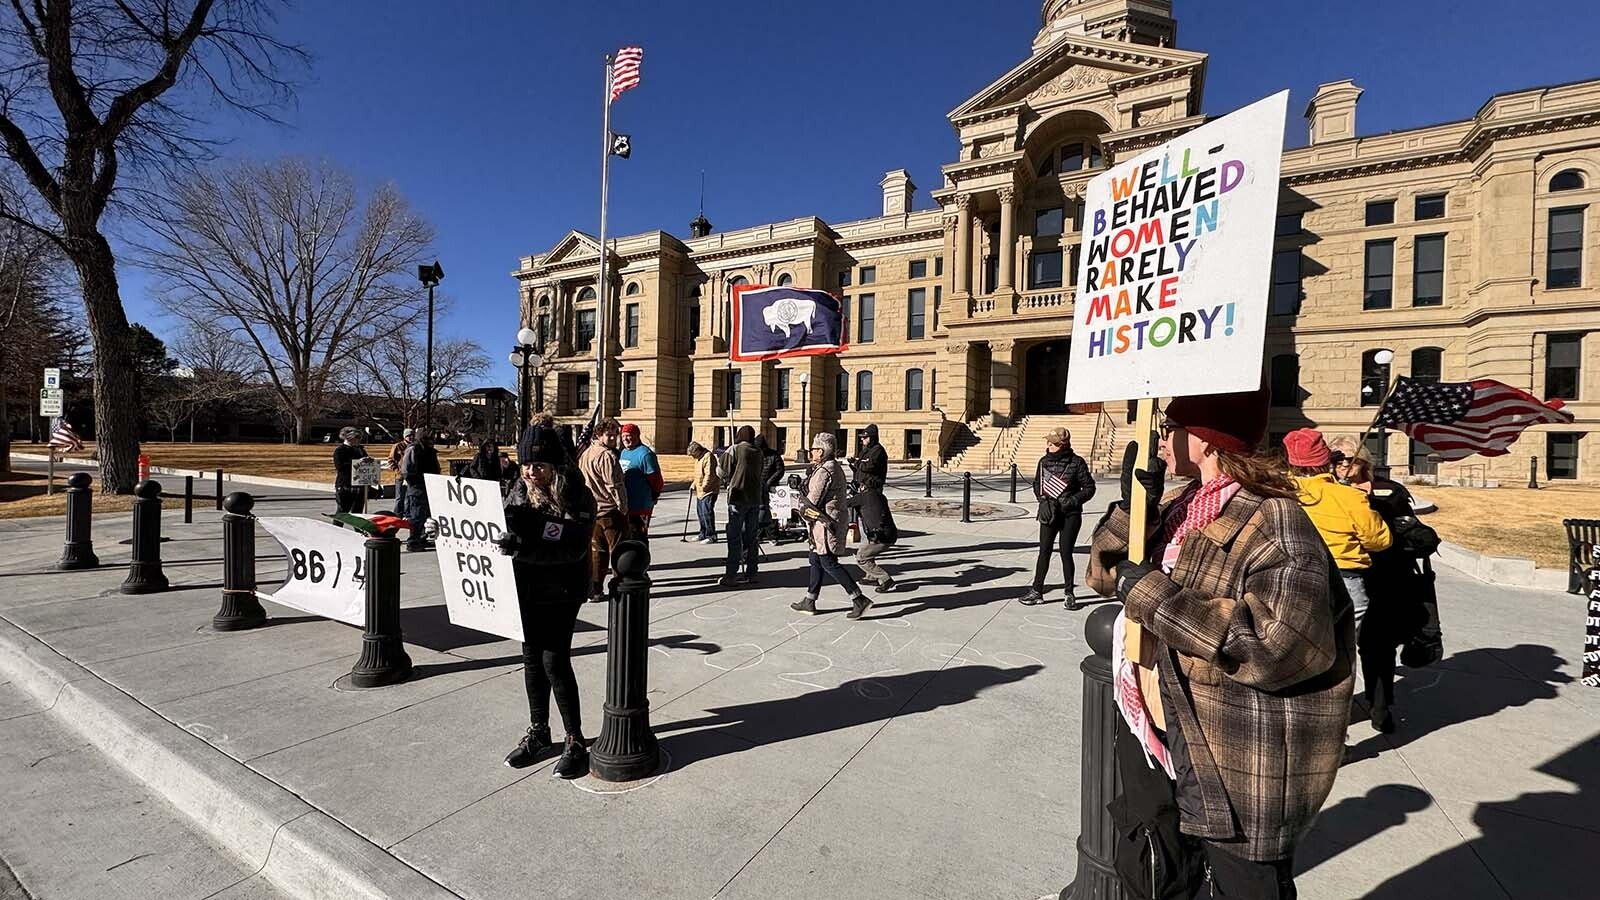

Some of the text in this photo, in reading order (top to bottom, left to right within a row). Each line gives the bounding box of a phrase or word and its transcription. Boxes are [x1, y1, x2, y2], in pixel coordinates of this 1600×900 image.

[1093, 159, 1245, 236] BEHAVED
[1087, 199, 1219, 266] WOMEN
[1085, 239, 1198, 294] RARELY
[1085, 276, 1179, 325] MAKE
[1088, 302, 1236, 359] HISTORY!
[447, 479, 477, 507] NO
[438, 515, 502, 545] BLOOD
[291, 548, 326, 584] 86
[456, 552, 494, 578] FOR
[461, 578, 495, 603] OIL
